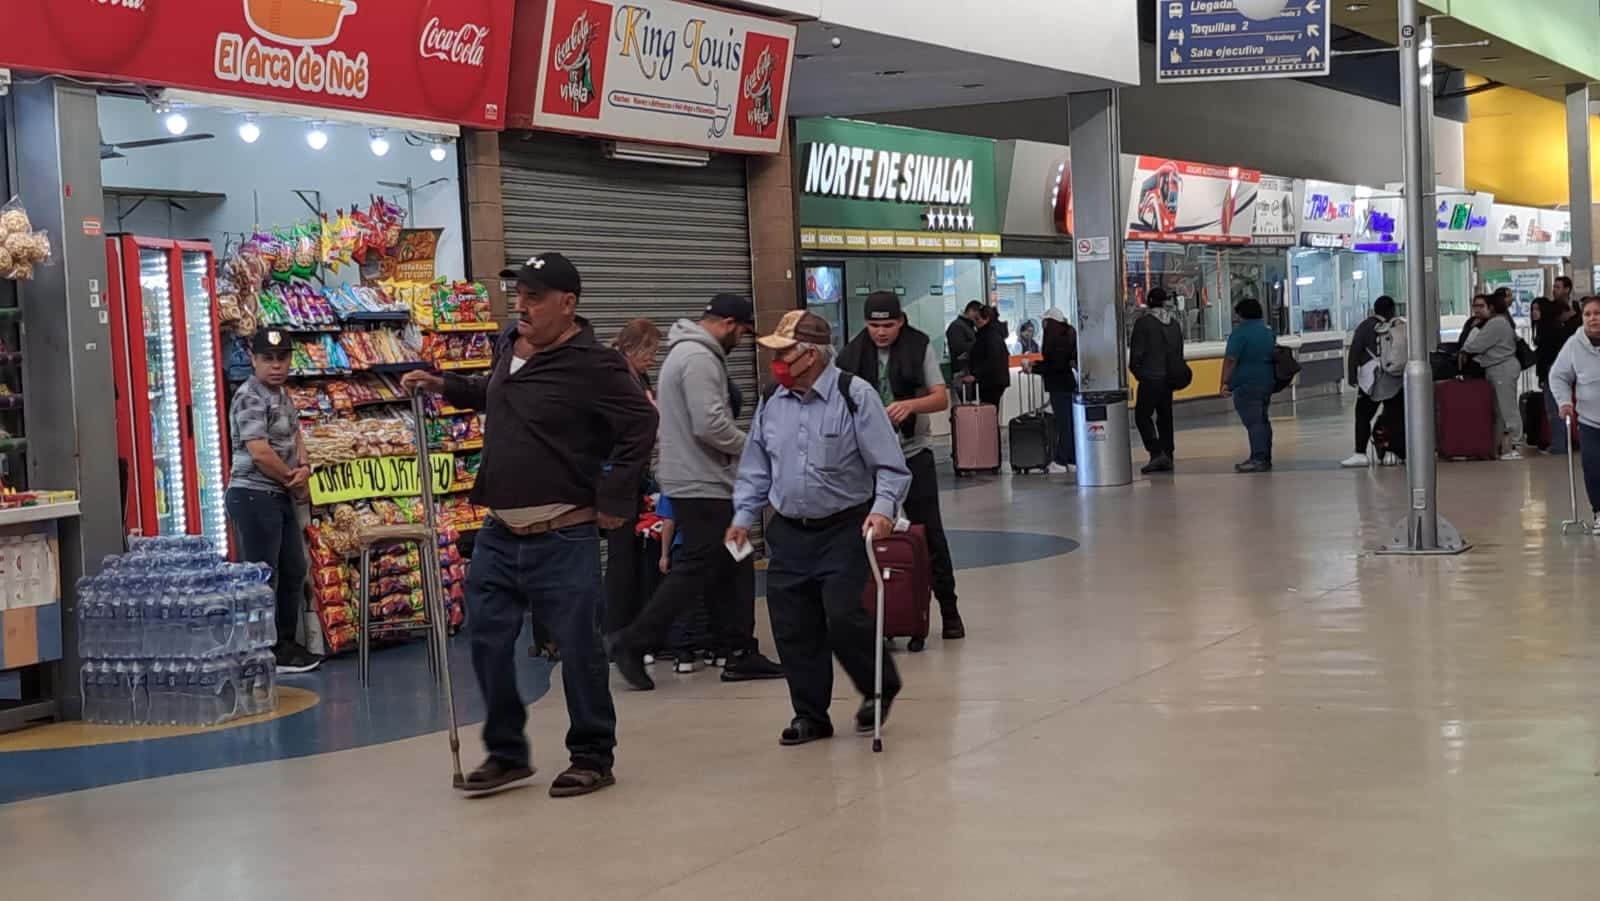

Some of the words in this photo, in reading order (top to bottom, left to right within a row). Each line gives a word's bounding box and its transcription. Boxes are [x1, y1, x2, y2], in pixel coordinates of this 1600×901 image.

[1190, 0, 1234, 13] Llegada
[1190, 22, 1237, 36] Taquillas
[1241, 21, 1249, 31] 2
[614, 5, 677, 81] King
[681, 19, 742, 86] Louis
[1190, 47, 1213, 58] Sala
[1215, 45, 1264, 59] ejecutiva
[218, 36, 240, 77] El
[244, 40, 291, 85] Arca
[298, 50, 323, 90] de
[328, 53, 368, 95] Noé
[806, 143, 873, 197] NORTE
[873, 150, 900, 200] DE
[900, 154, 973, 204] SINALOA
[313, 462, 356, 493] TORTA
